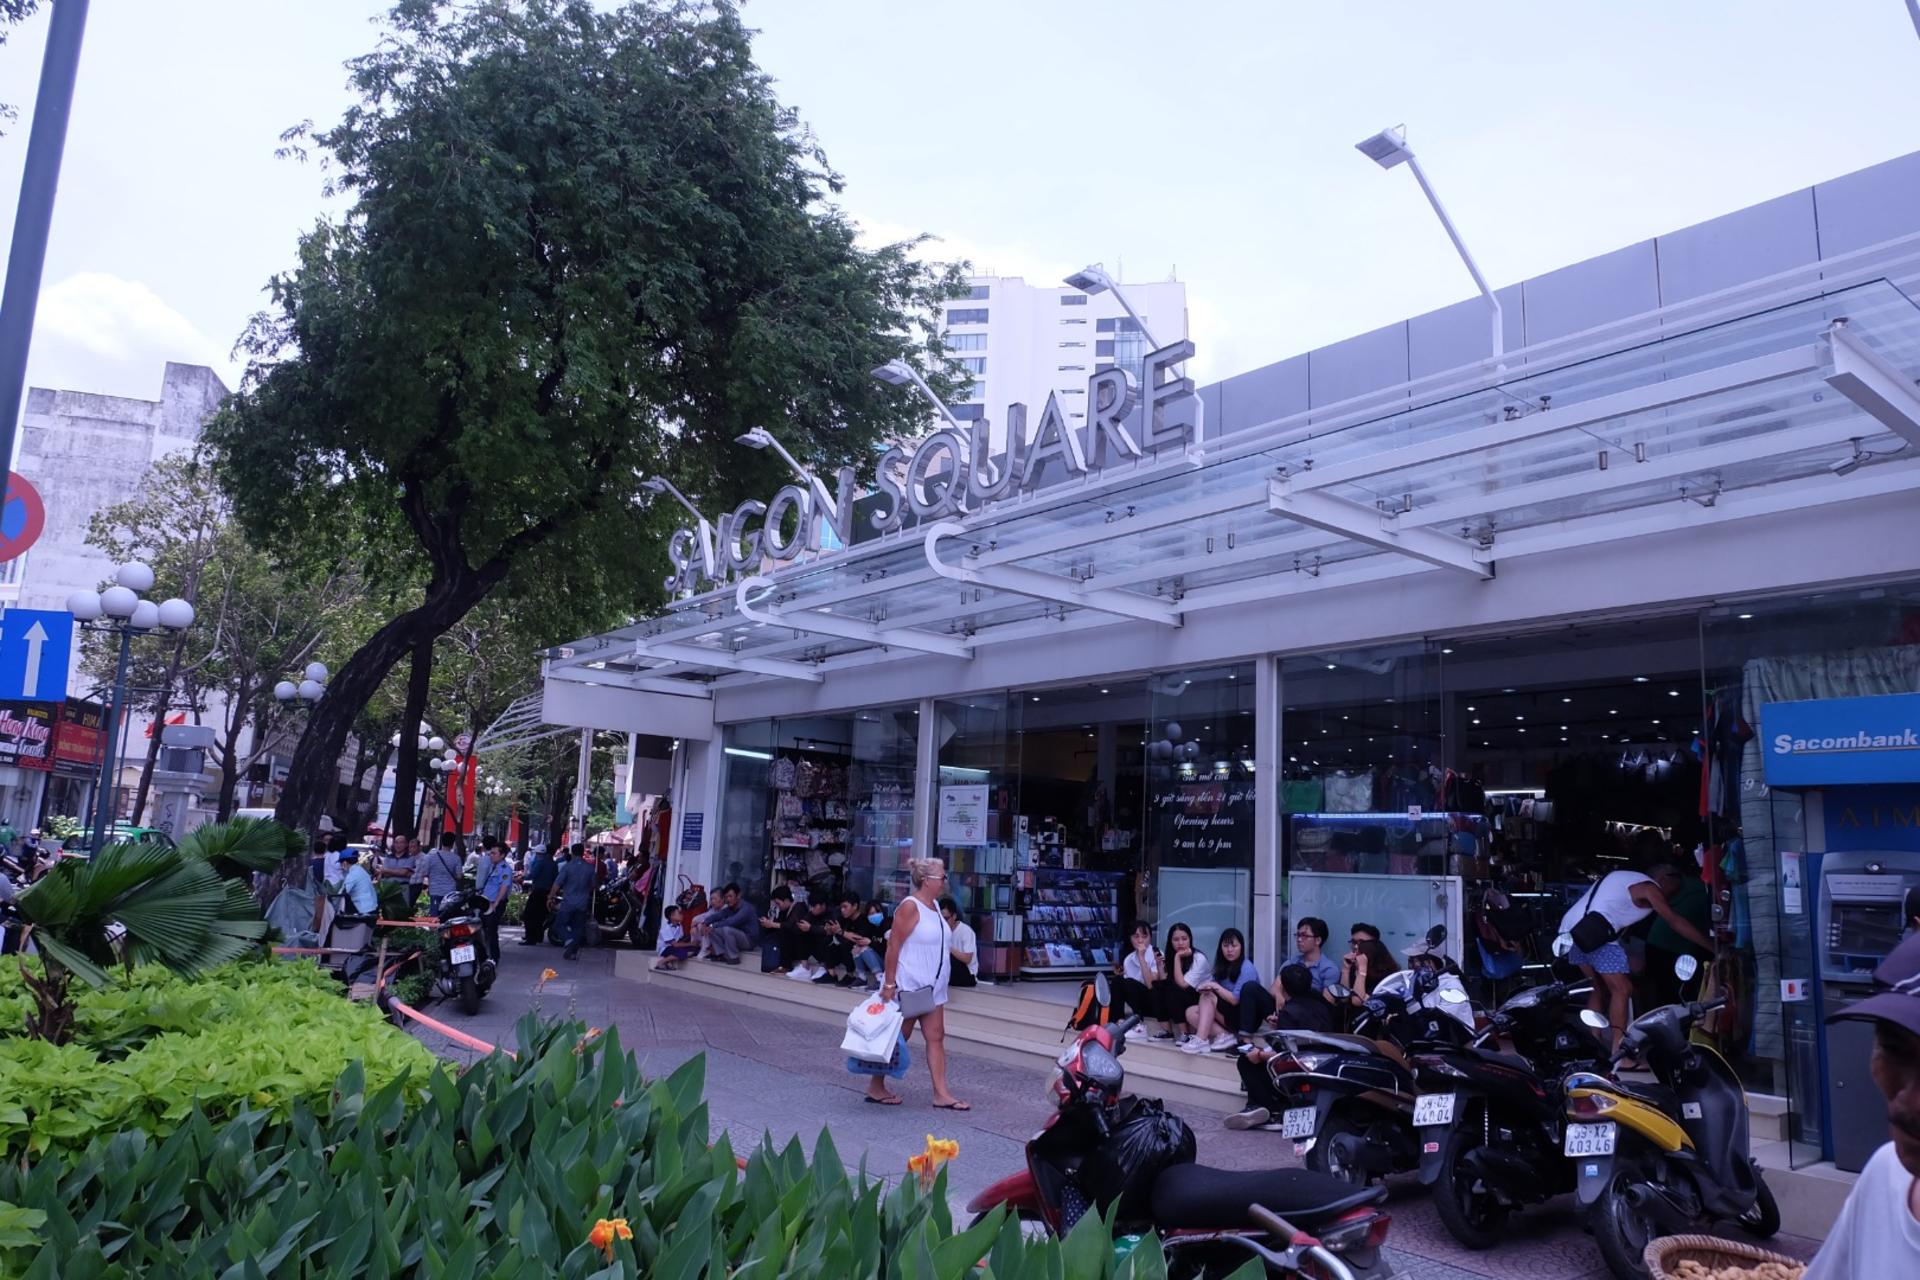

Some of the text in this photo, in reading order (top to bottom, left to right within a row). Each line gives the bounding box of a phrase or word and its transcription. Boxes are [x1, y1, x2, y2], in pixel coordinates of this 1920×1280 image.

[664, 339, 1196, 592] SAIGON SQUARE
[1774, 728, 1919, 754] Sacombank
[1174, 813, 1234, 830] Opening hours
[1840, 804, 1920, 828] ATM
[1173, 839, 1180, 848] 9
[1181, 840, 1195, 849] am
[1207, 839, 1214, 848] 9
[1215, 838, 1232, 853] pm
[1574, 1125, 1608, 1139] 59-X2
[1569, 1139, 1610, 1154] 403.46
